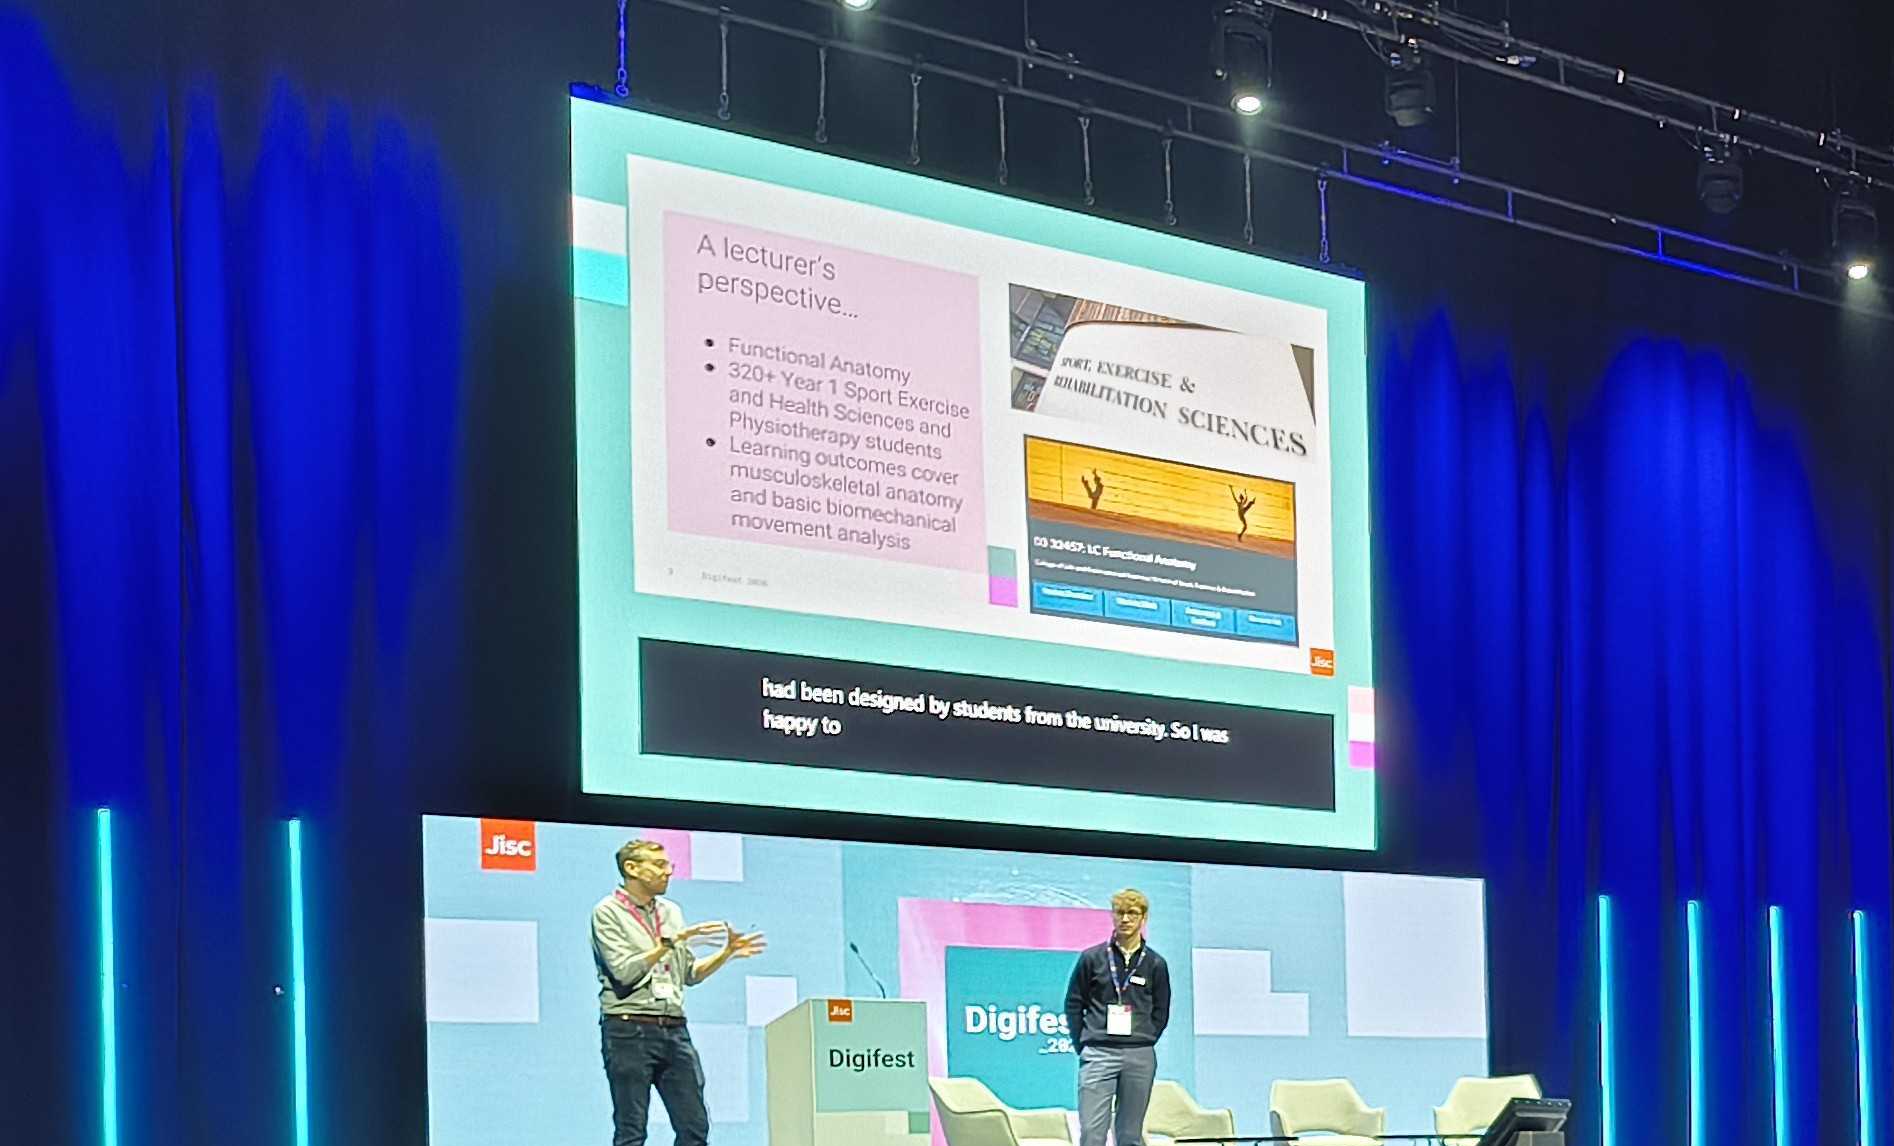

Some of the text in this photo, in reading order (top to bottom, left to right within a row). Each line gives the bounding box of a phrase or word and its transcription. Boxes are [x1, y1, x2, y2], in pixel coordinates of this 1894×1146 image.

[697, 234, 716, 257] A
[698, 272, 859, 319] perspective...
[728, 337, 912, 387] Functional Anatomy
[1097, 360, 1172, 389] EXERCISE
[1180, 376, 1196, 394] &
[728, 361, 971, 420] 320+ Year 1 Sport Exercise
[729, 388, 952, 439] and Health Sciences and
[730, 411, 943, 460] Physiotherapy students
[1054, 375, 1308, 457] REHABILITATION SCIENCES
[730, 436, 959, 486] Learning outcomes cover
[730, 463, 964, 514] musculoskeletal anatomy
[730, 487, 957, 533] and basic biomechanical
[731, 512, 911, 550] movement analysis
[762, 677, 1229, 744] had been designed by students from the university. So I was
[762, 708, 842, 737] happy to
[485, 833, 532, 857] Jisc
[965, 1003, 1071, 1041] Digifes
[829, 1048, 915, 1072] Digifest
